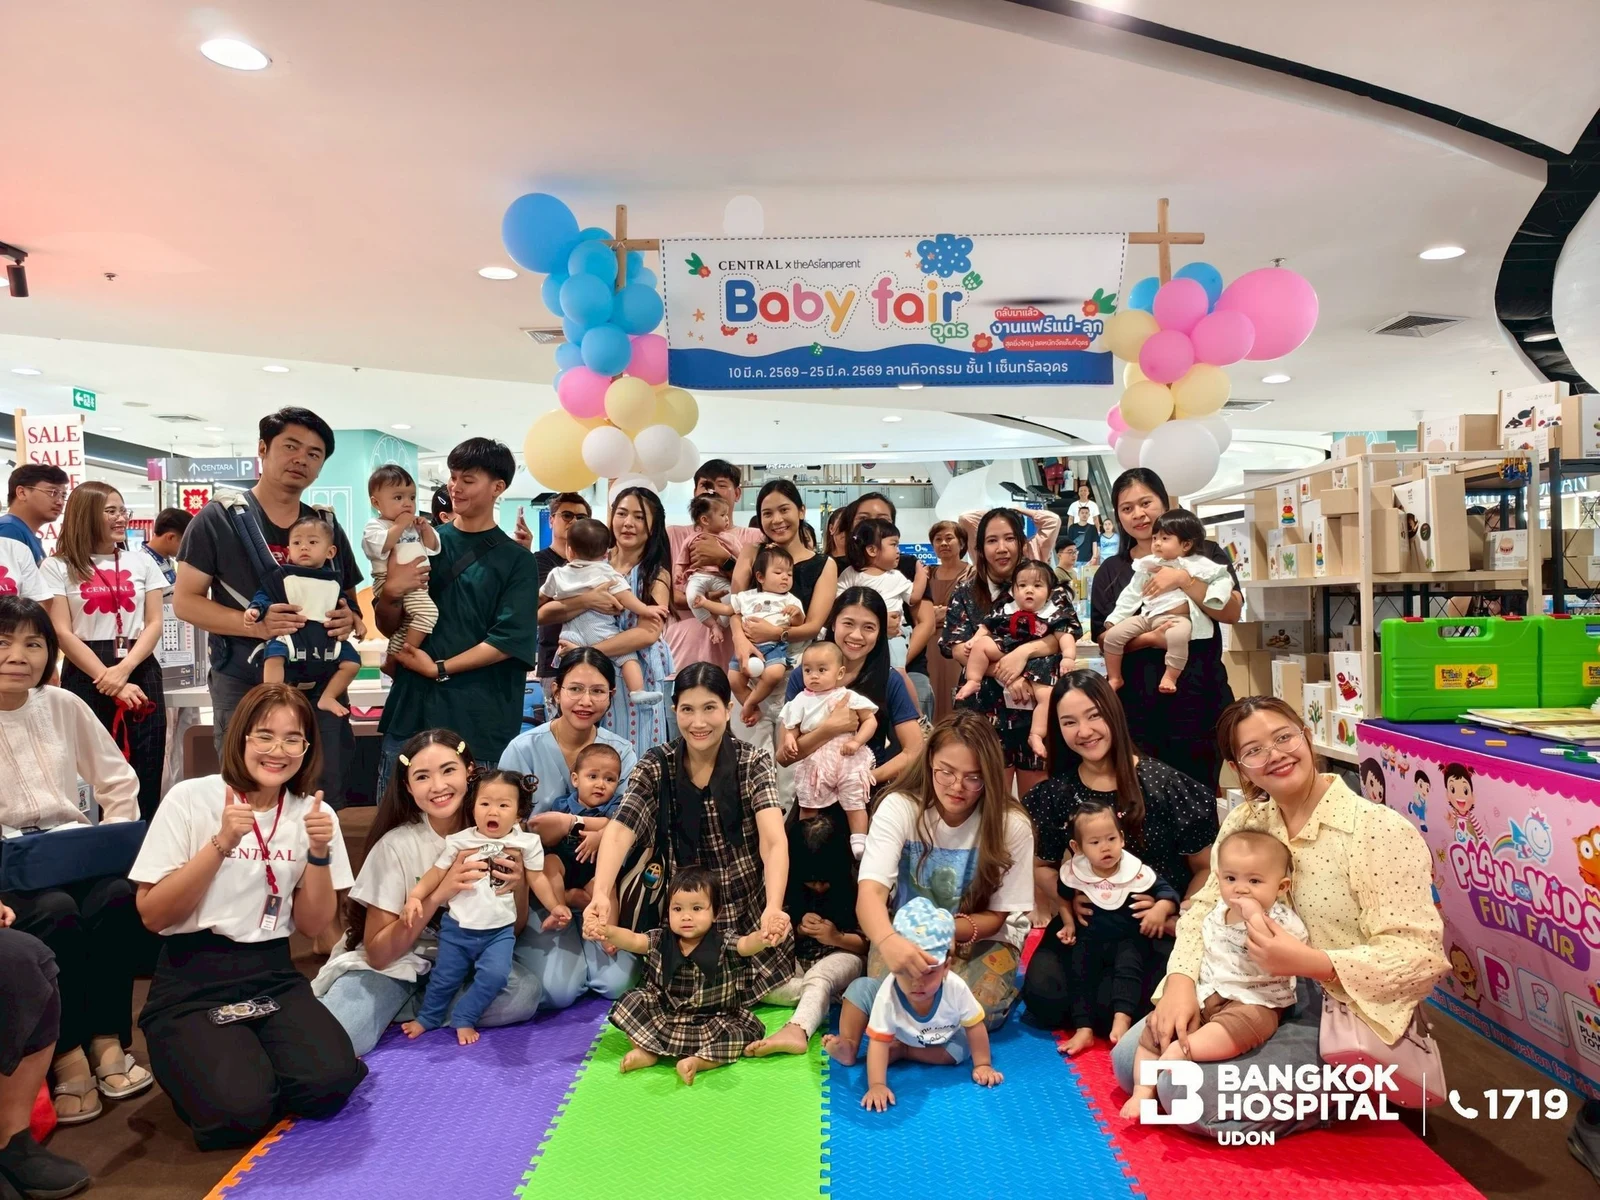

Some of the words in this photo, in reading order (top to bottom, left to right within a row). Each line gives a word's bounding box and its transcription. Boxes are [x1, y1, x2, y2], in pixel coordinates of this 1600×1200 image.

[718, 260, 783, 271] CENTRAL
[793, 258, 861, 271] theAsianparent
[725, 279, 856, 333] Baby
[871, 276, 964, 324] fair
[996, 306, 1039, 317] กลับมาแล้ว
[931, 323, 969, 344] อุดร
[728, 367, 742, 378] 10
[769, 366, 799, 378] 2569
[809, 366, 824, 377] 25
[852, 365, 883, 377] 2569
[886, 362, 962, 376] ลานกิจกรรม
[966, 357, 984, 374] ชั้น
[987, 361, 992, 374] 1
[28, 425, 81, 444] SALE
[30, 449, 82, 467] SALE
[201, 463, 234, 472] CENTARA
[241, 460, 253, 476] P
[1450, 842, 1517, 900] PLAN
[1513, 883, 1531, 900] FOR
[1478, 896, 1521, 932] FUN
[1526, 914, 1575, 964] FAIR
